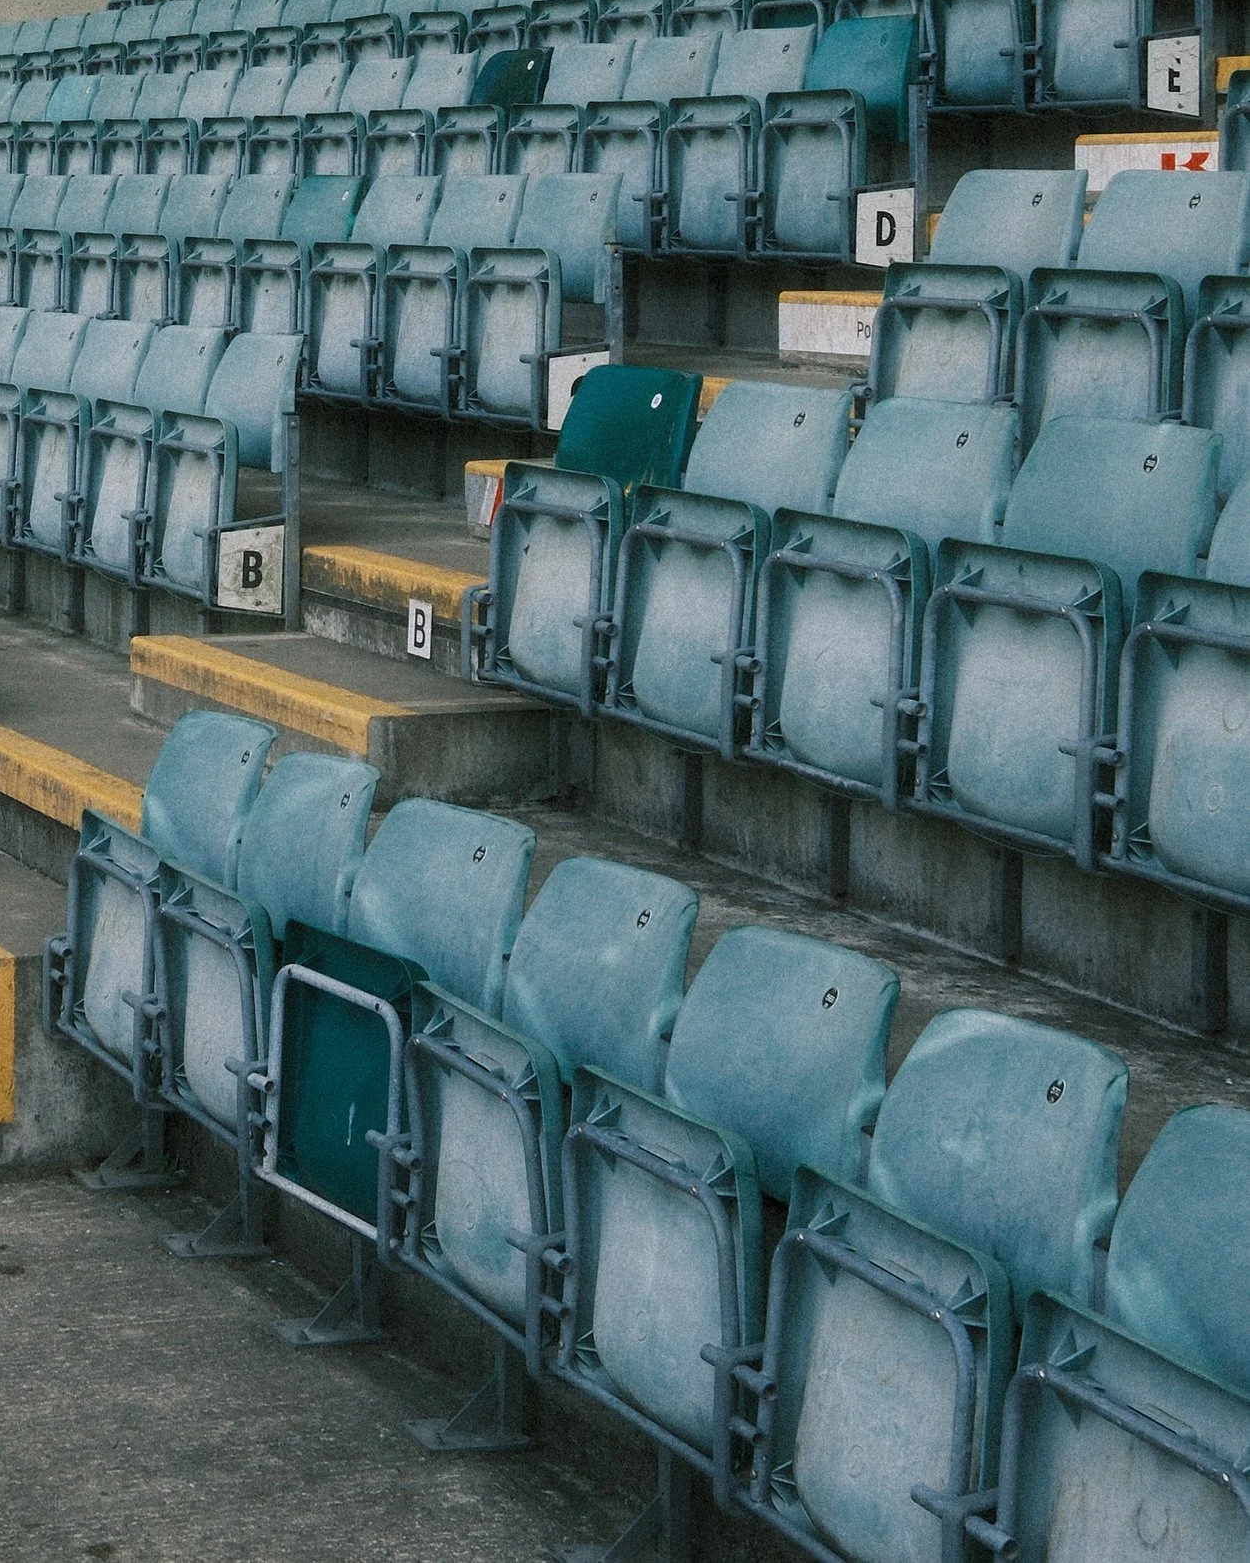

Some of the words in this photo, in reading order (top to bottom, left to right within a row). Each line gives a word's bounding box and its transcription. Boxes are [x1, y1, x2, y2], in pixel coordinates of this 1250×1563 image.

[876, 210, 896, 248] D
[242, 550, 262, 590] B
[414, 608, 427, 650] B
